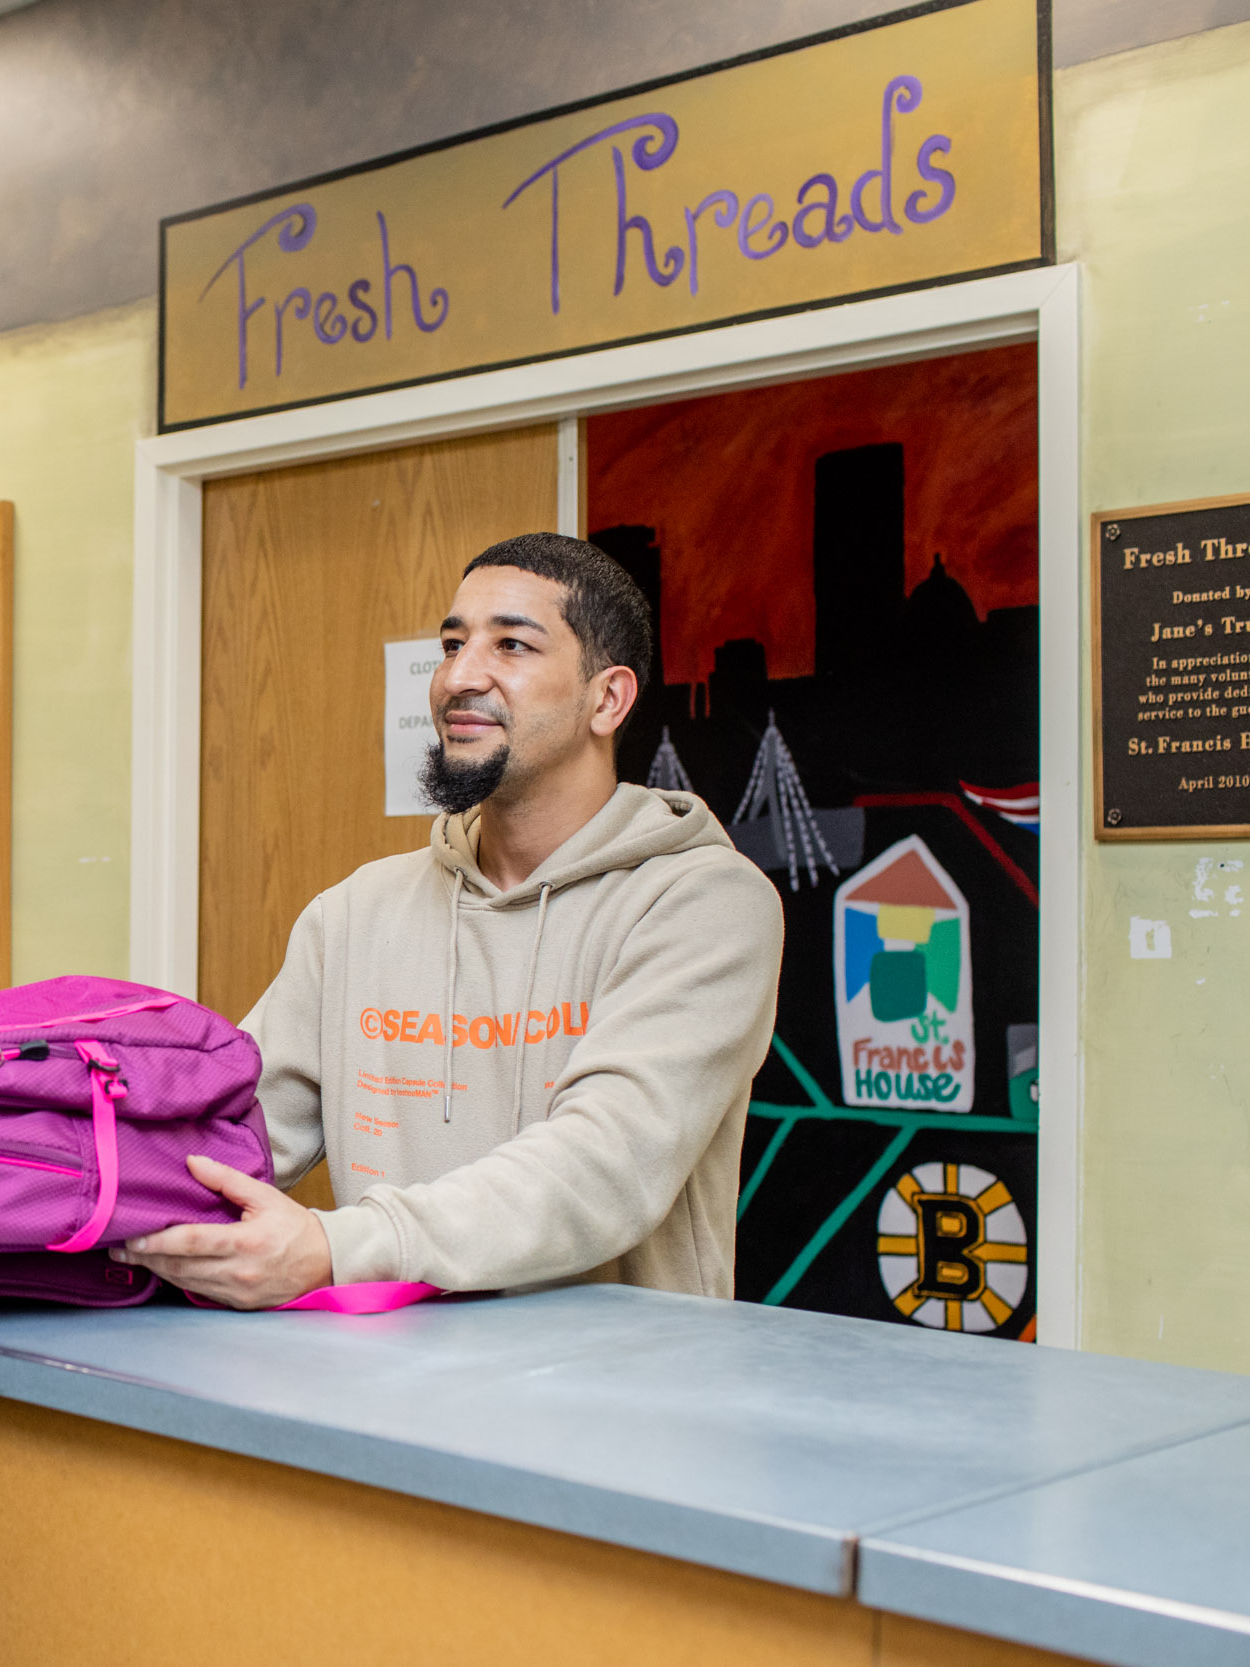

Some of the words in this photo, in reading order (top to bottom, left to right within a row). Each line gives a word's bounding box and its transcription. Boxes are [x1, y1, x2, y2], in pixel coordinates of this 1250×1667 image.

[198, 202, 449, 391] Fresh
[501, 73, 958, 316] Threads
[1123, 541, 1192, 571] Fresh
[1200, 537, 1250, 562] Thr
[1172, 586, 1231, 605] Donated
[1151, 618, 1214, 643] Jane's
[409, 660, 443, 675] CLOT
[1152, 656, 1167, 671] In
[1171, 651, 1250, 672] appreciatio
[1146, 673, 1167, 688] the
[1170, 673, 1207, 688] many
[1210, 668, 1250, 683] volun
[1138, 690, 1165, 704] who
[1168, 686, 1220, 706] provide
[1224, 684, 1250, 699] ded
[398, 714, 434, 729] DEPA
[1137, 707, 1184, 721] service
[1188, 707, 1202, 718] to
[1206, 703, 1228, 717] the
[1231, 705, 1250, 719] gu
[1128, 737, 1154, 756] St.
[1157, 734, 1232, 755] Francis
[1178, 776, 1215, 793] April
[1218, 774, 1250, 789] 2010
[911, 1009, 950, 1046] St.
[852, 1037, 966, 1074] Francis
[351, 1162, 380, 1177] Edition
[913, 1192, 986, 1301] B
